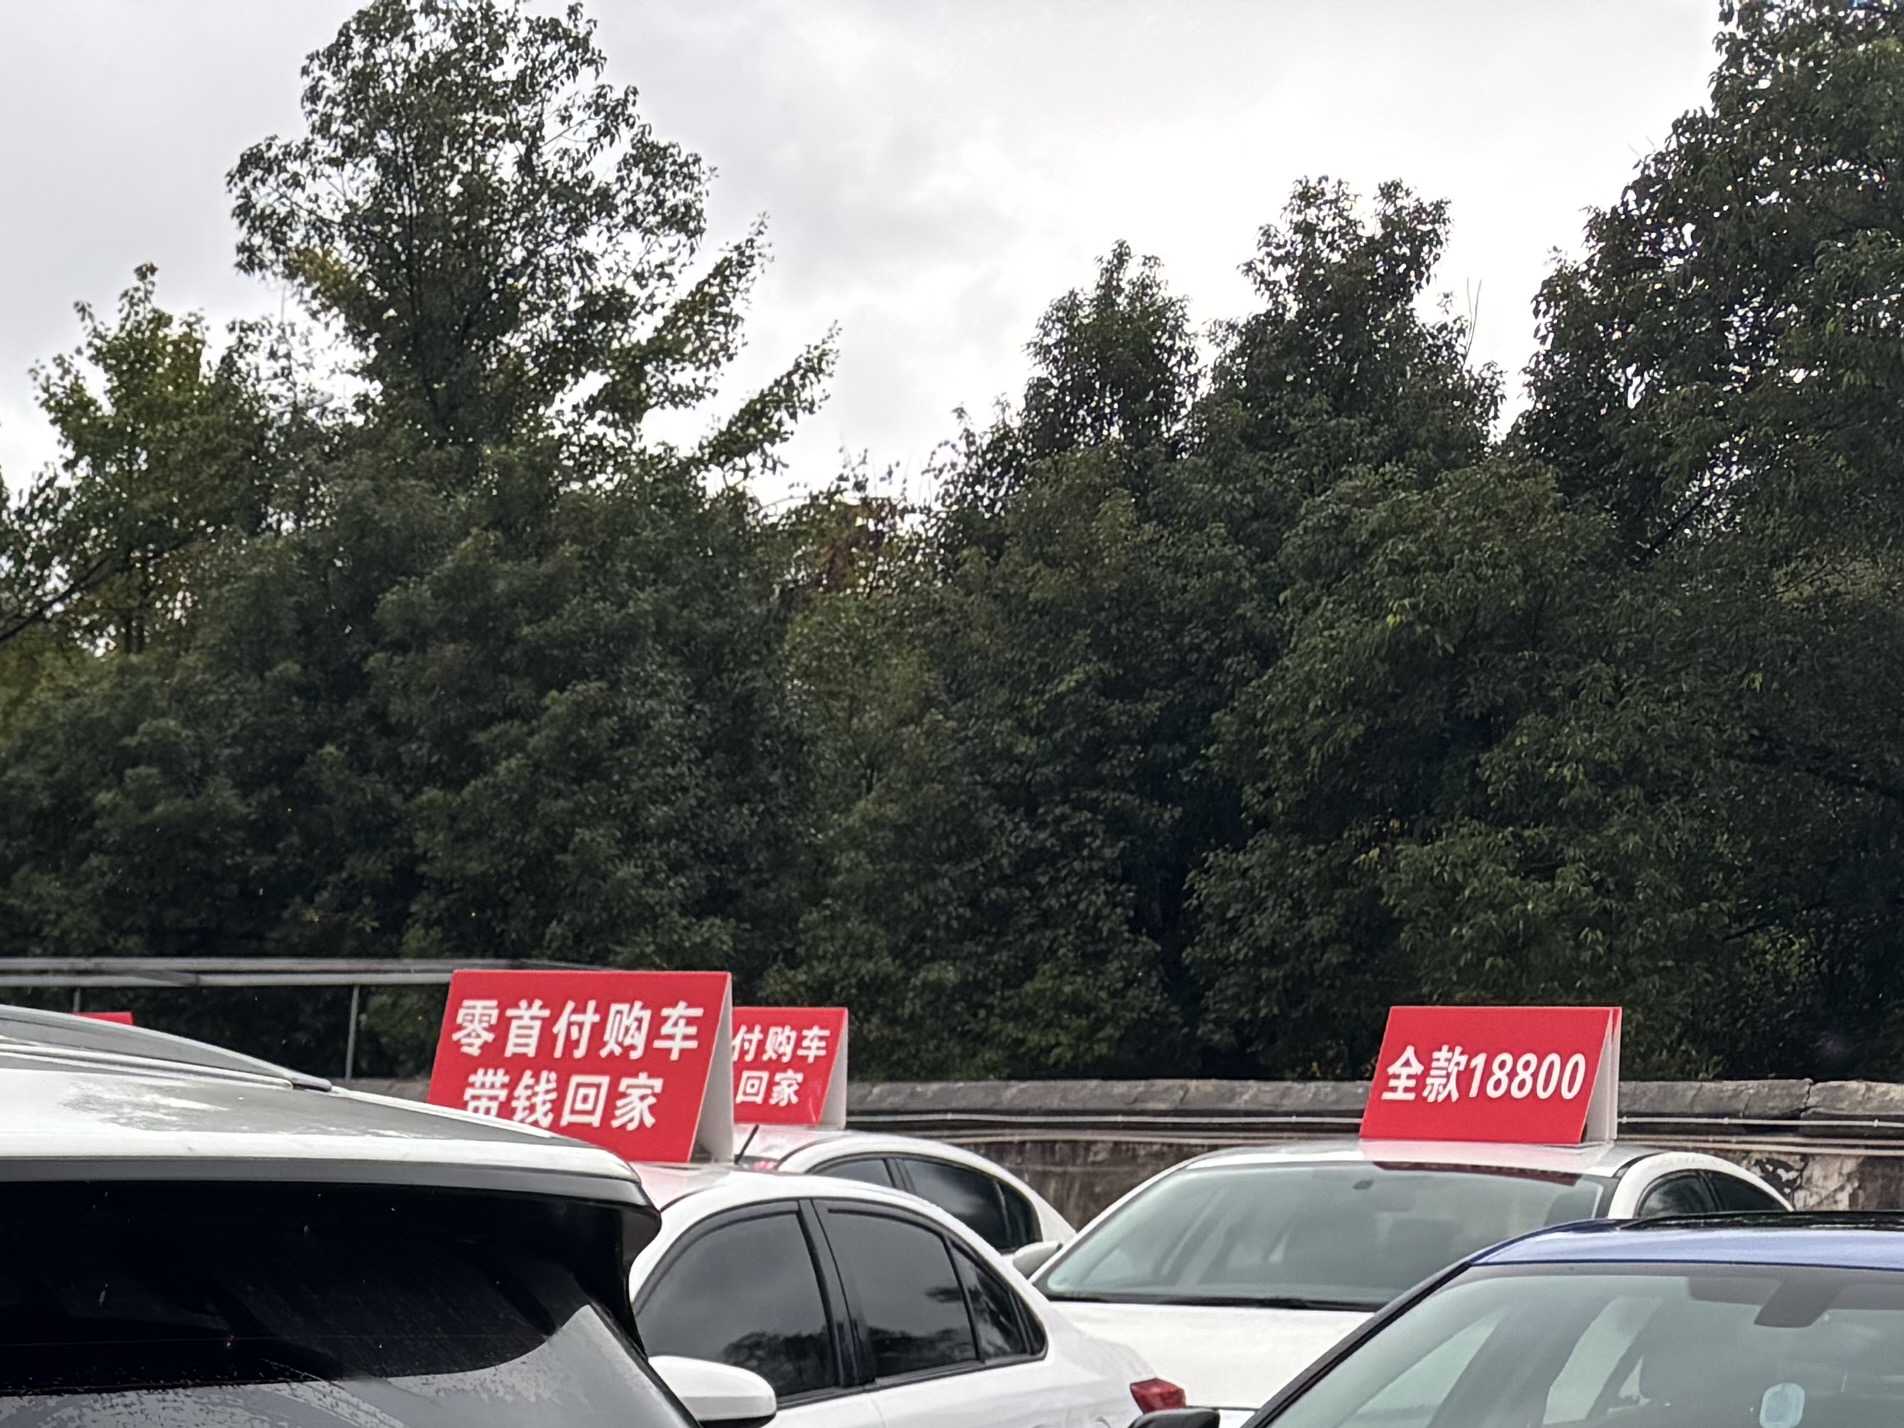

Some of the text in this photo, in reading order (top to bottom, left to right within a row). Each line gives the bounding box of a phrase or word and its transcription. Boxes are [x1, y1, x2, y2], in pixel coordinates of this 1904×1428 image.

[452, 1000, 704, 1061] 零首付购车
[461, 1068, 664, 1132] 带钱回家
[734, 1069, 805, 1107] 回家
[1381, 1045, 1586, 1103] 全款18800
